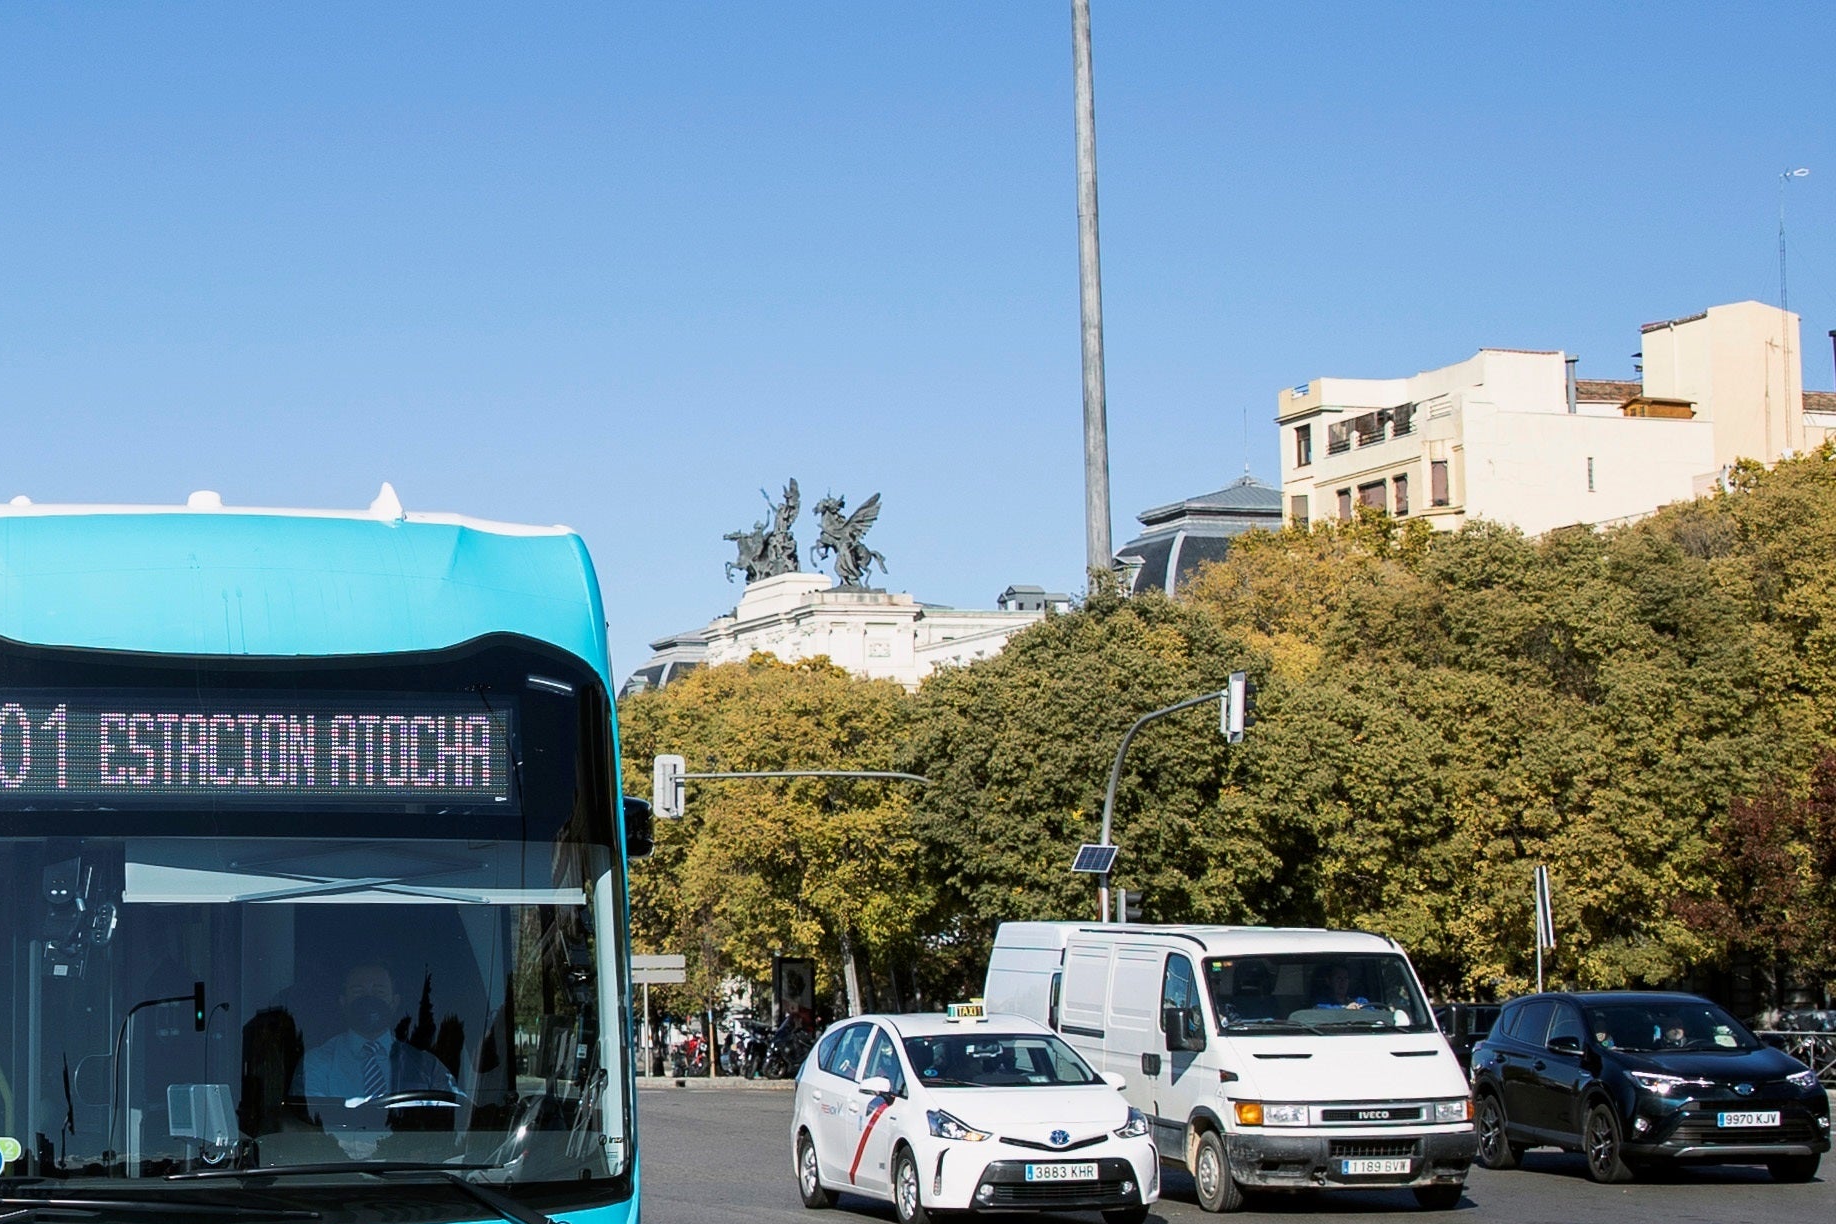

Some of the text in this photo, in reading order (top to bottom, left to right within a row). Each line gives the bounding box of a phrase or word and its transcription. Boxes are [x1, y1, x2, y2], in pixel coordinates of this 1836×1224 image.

[100, 712, 315, 786] ESTACION
[330, 714, 491, 787] ATOCHA
[957, 1006, 981, 1017] TAXI
[1358, 1111, 1390, 1119] IVECO
[1725, 1114, 1754, 1125] 9970
[1035, 1165, 1094, 1179] 3883 KHR
[1353, 1161, 1381, 1172] 1189
